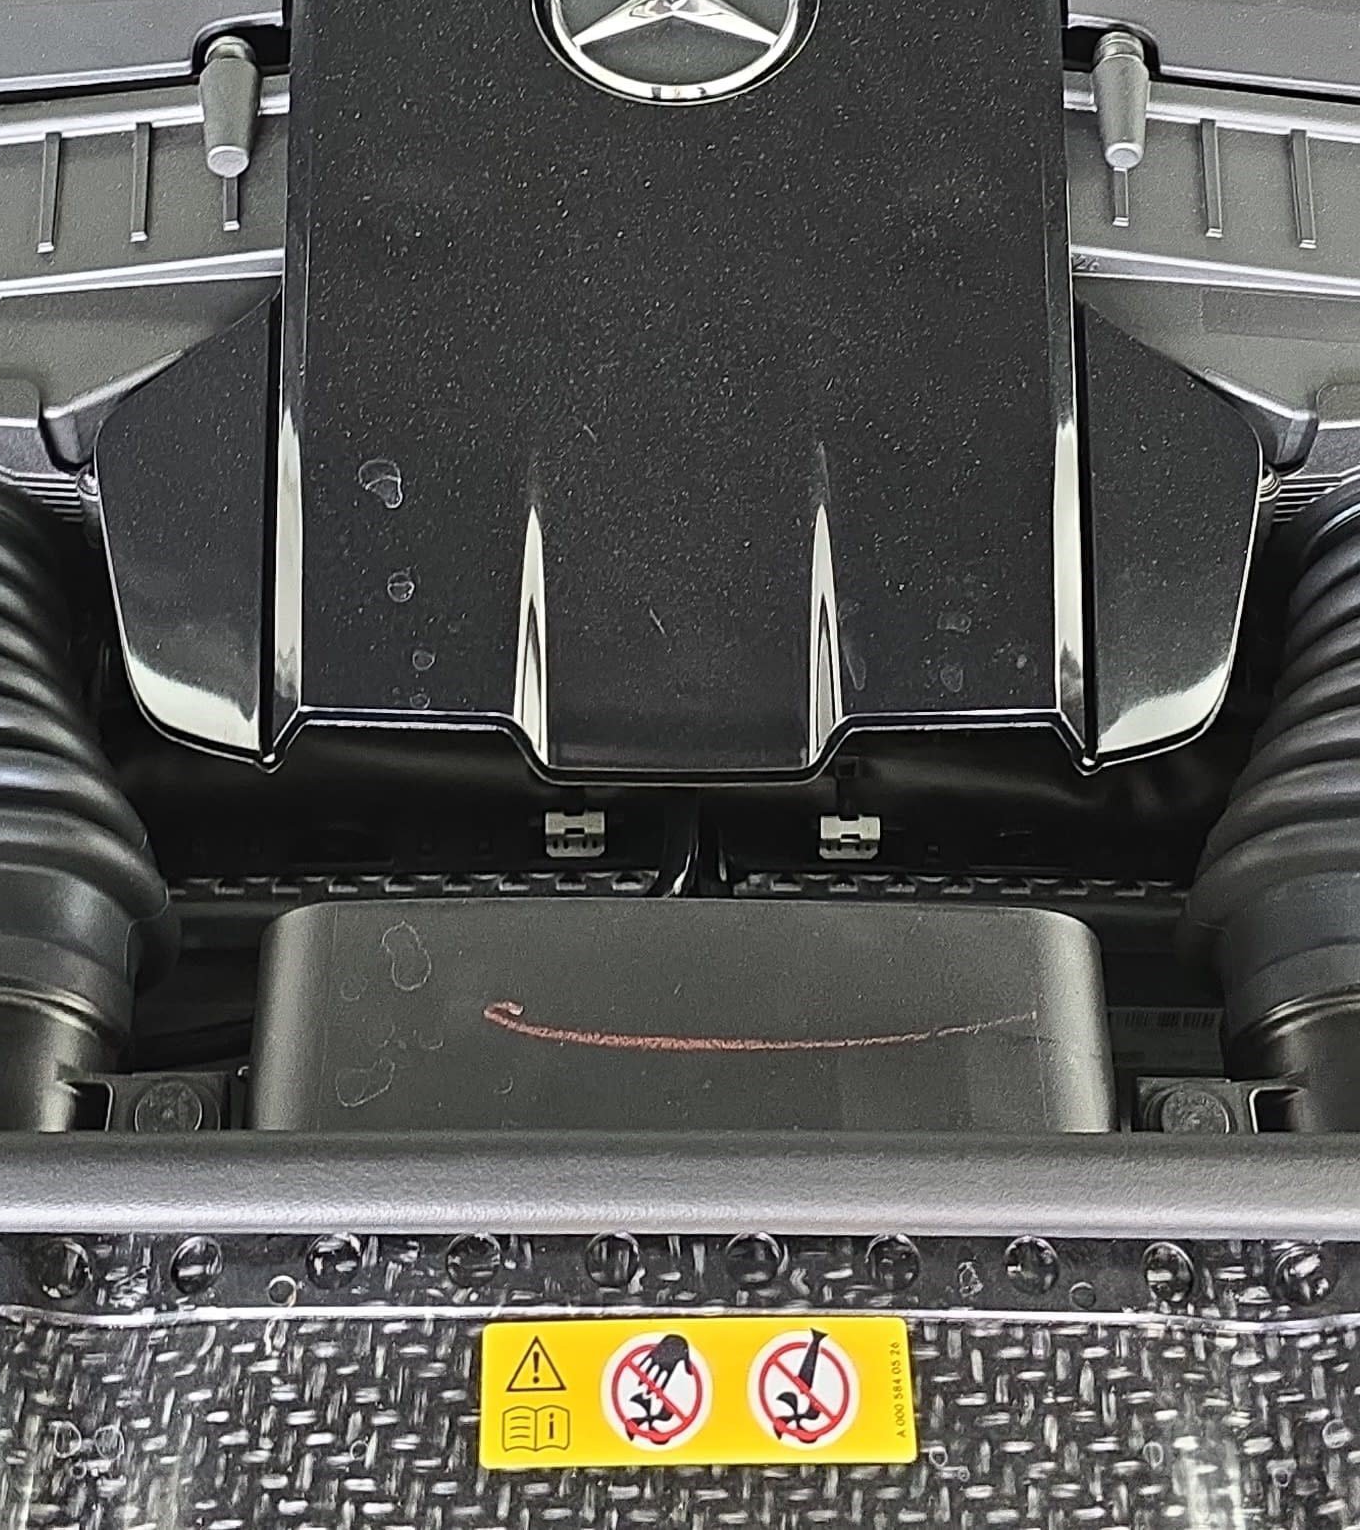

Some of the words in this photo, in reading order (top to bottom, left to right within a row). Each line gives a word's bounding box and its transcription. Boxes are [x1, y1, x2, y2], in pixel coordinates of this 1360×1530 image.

[889, 1341, 900, 1356] 26
[891, 1360, 902, 1375] 05
[892, 1379, 904, 1400] 584
[894, 1403, 906, 1427] 000
[896, 1429, 906, 1439] A
